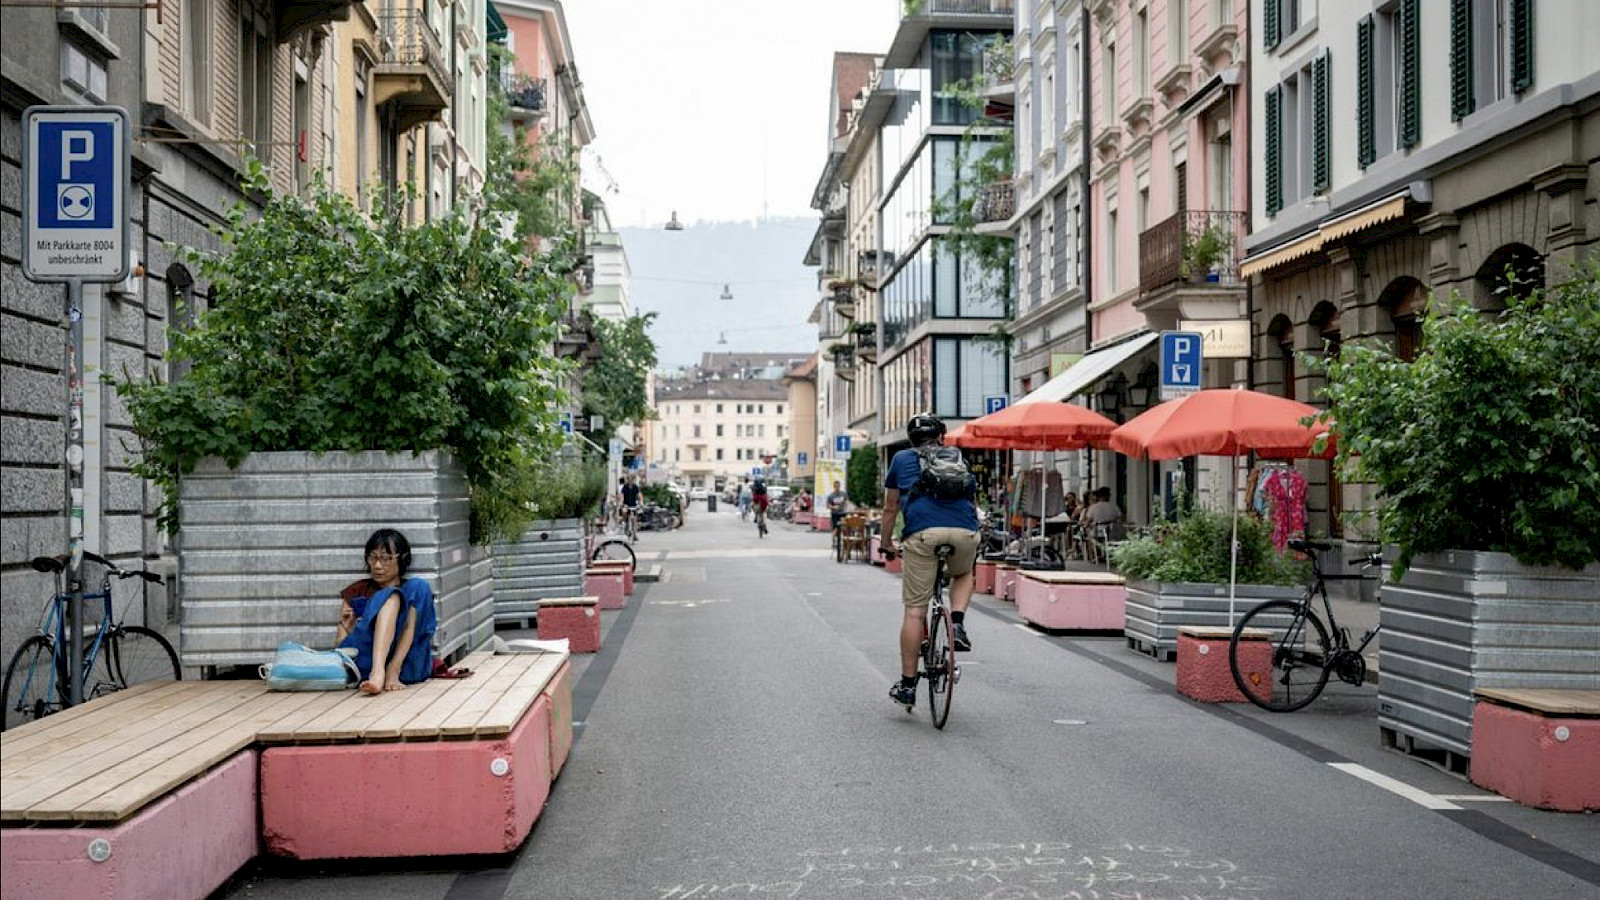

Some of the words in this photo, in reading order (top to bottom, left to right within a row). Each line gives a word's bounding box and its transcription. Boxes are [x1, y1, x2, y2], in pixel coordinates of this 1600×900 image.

[62, 130, 95, 180] P
[37, 240, 51, 250] Mit
[53, 240, 92, 250] Parkkarte
[93, 240, 115, 250] 8004
[48, 254, 103, 265] unbeschränkt
[1174, 338, 1191, 362] P
[991, 398, 1002, 413] P
